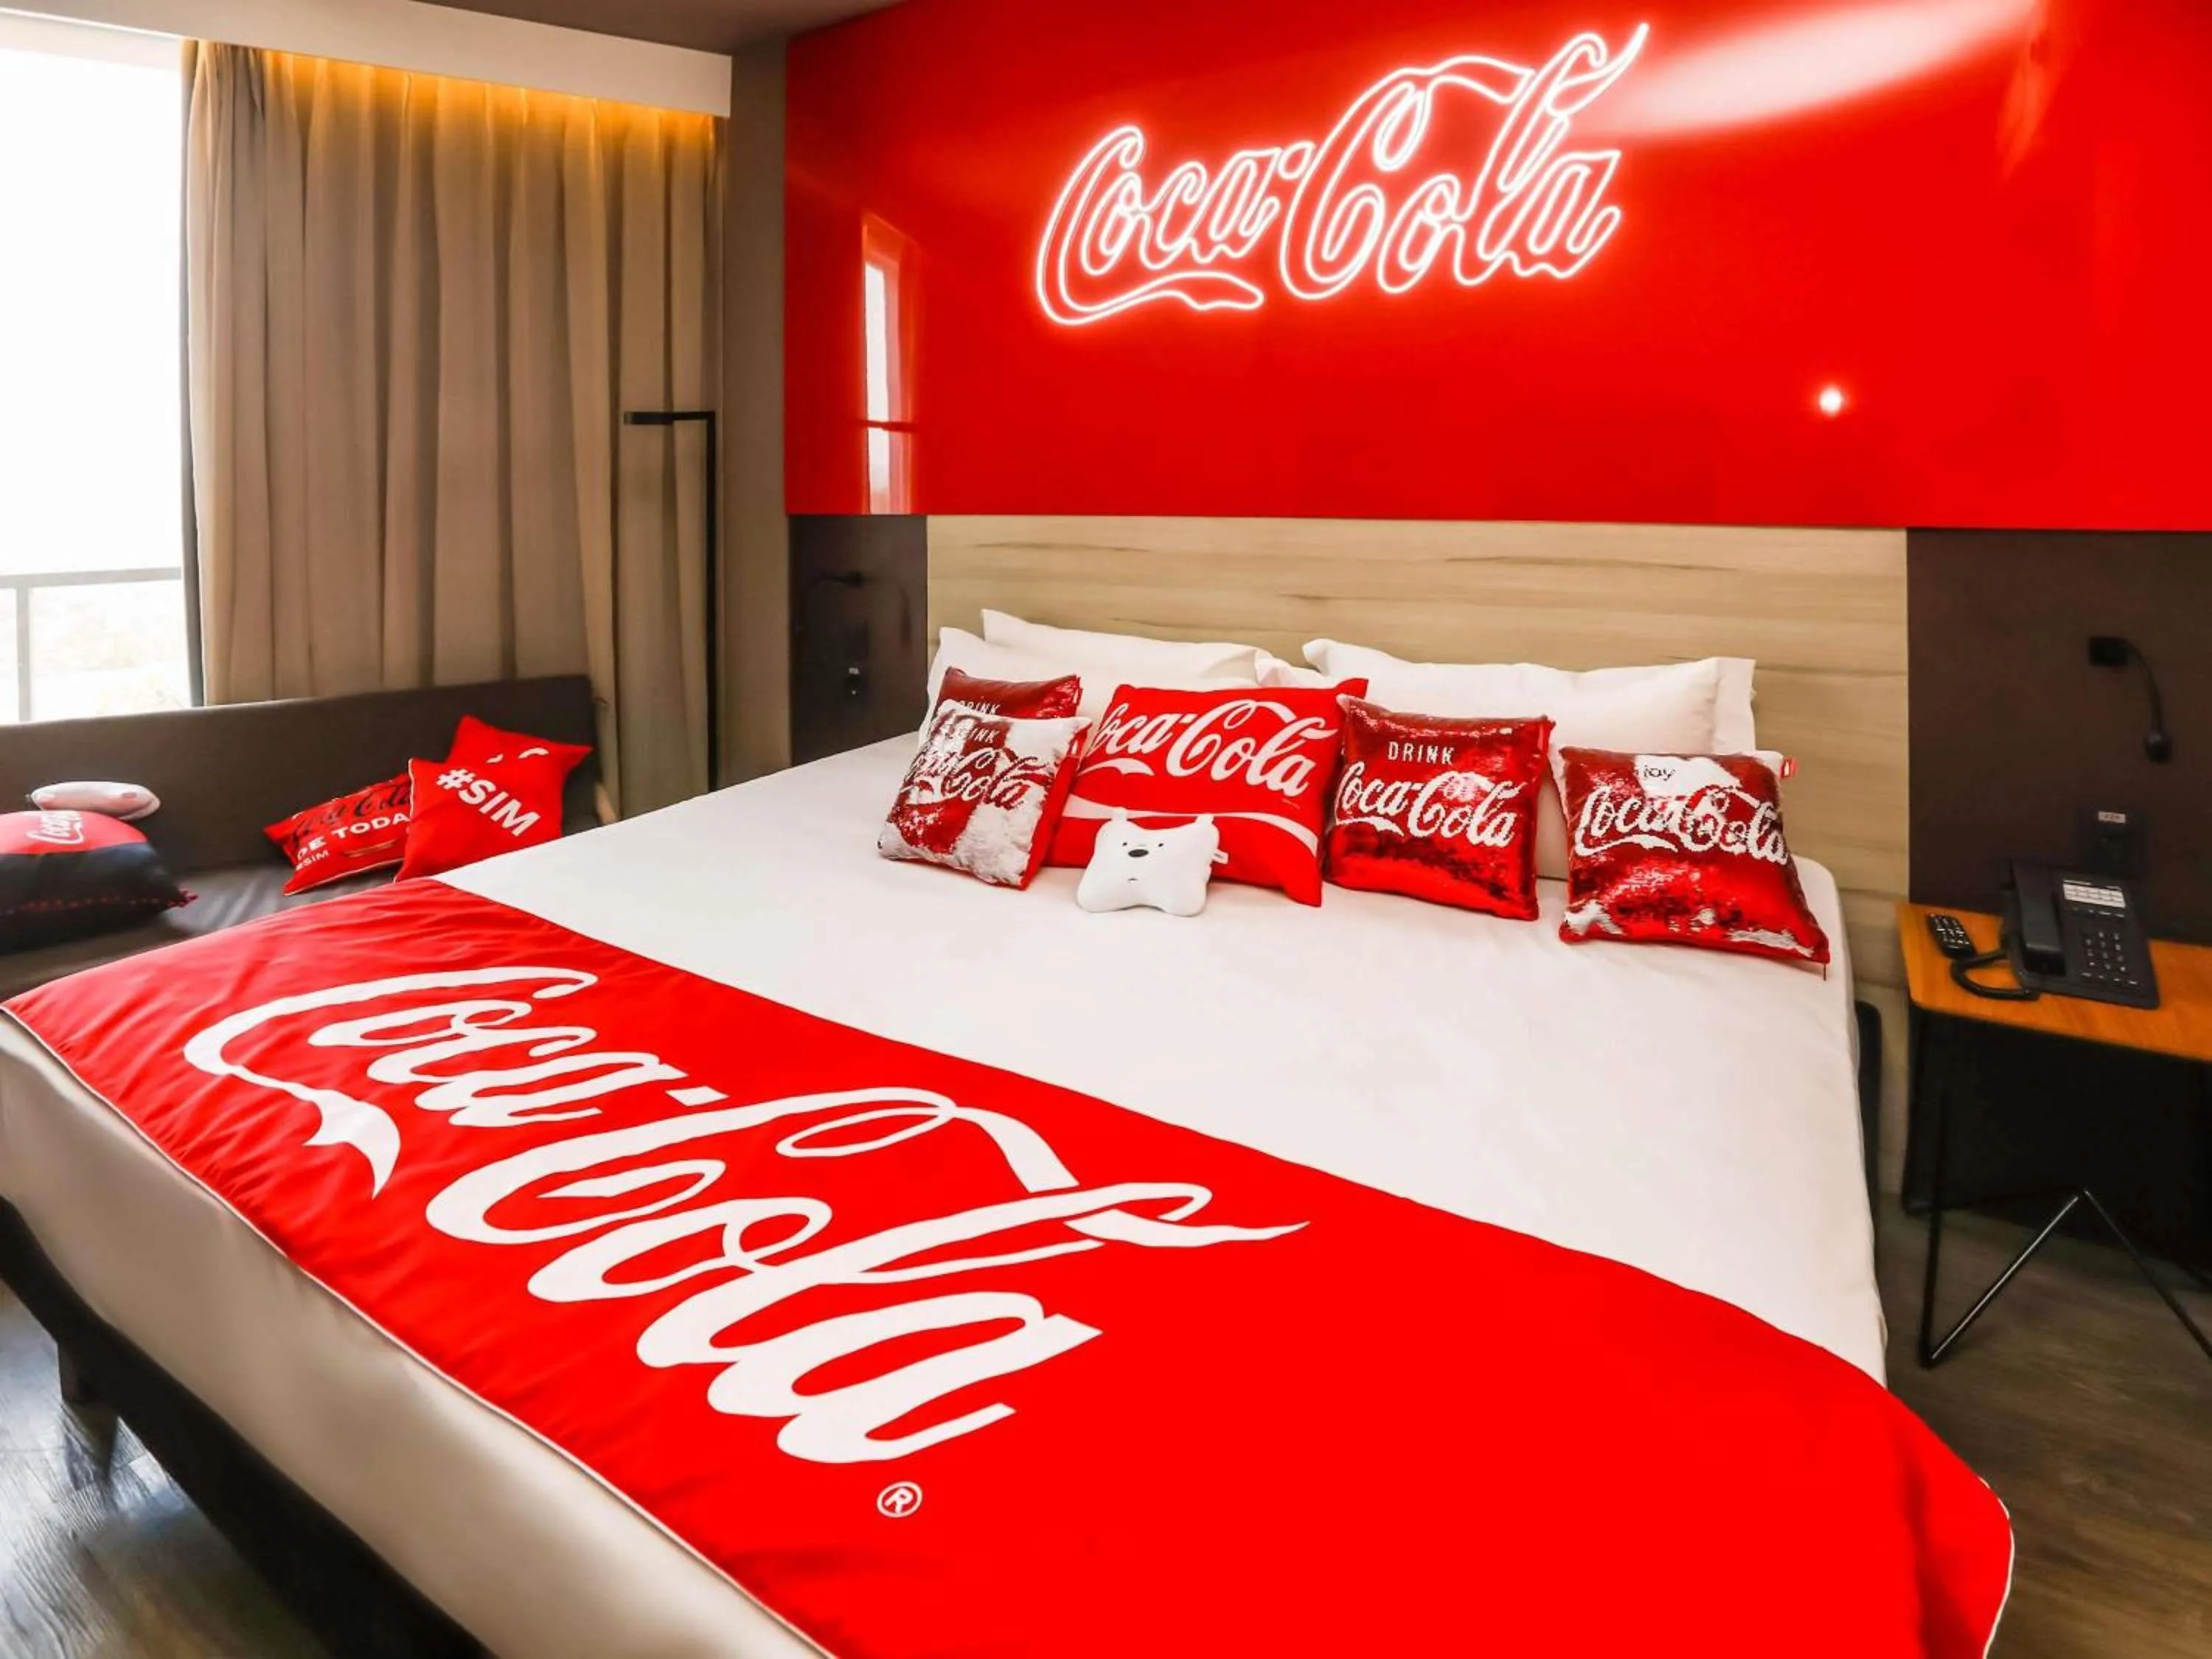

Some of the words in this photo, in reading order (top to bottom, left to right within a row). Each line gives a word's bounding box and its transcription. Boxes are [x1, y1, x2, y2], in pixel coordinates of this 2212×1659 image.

[1035, 22, 1649, 326] Coca-Cola
[1388, 741, 1455, 765] DRINK
[436, 768, 541, 838] #SIM
[1334, 761, 1528, 848] Coca-Cola
[1574, 783, 1790, 866] Coca-Cola
[183, 965, 1310, 1464] Coca-Cola
